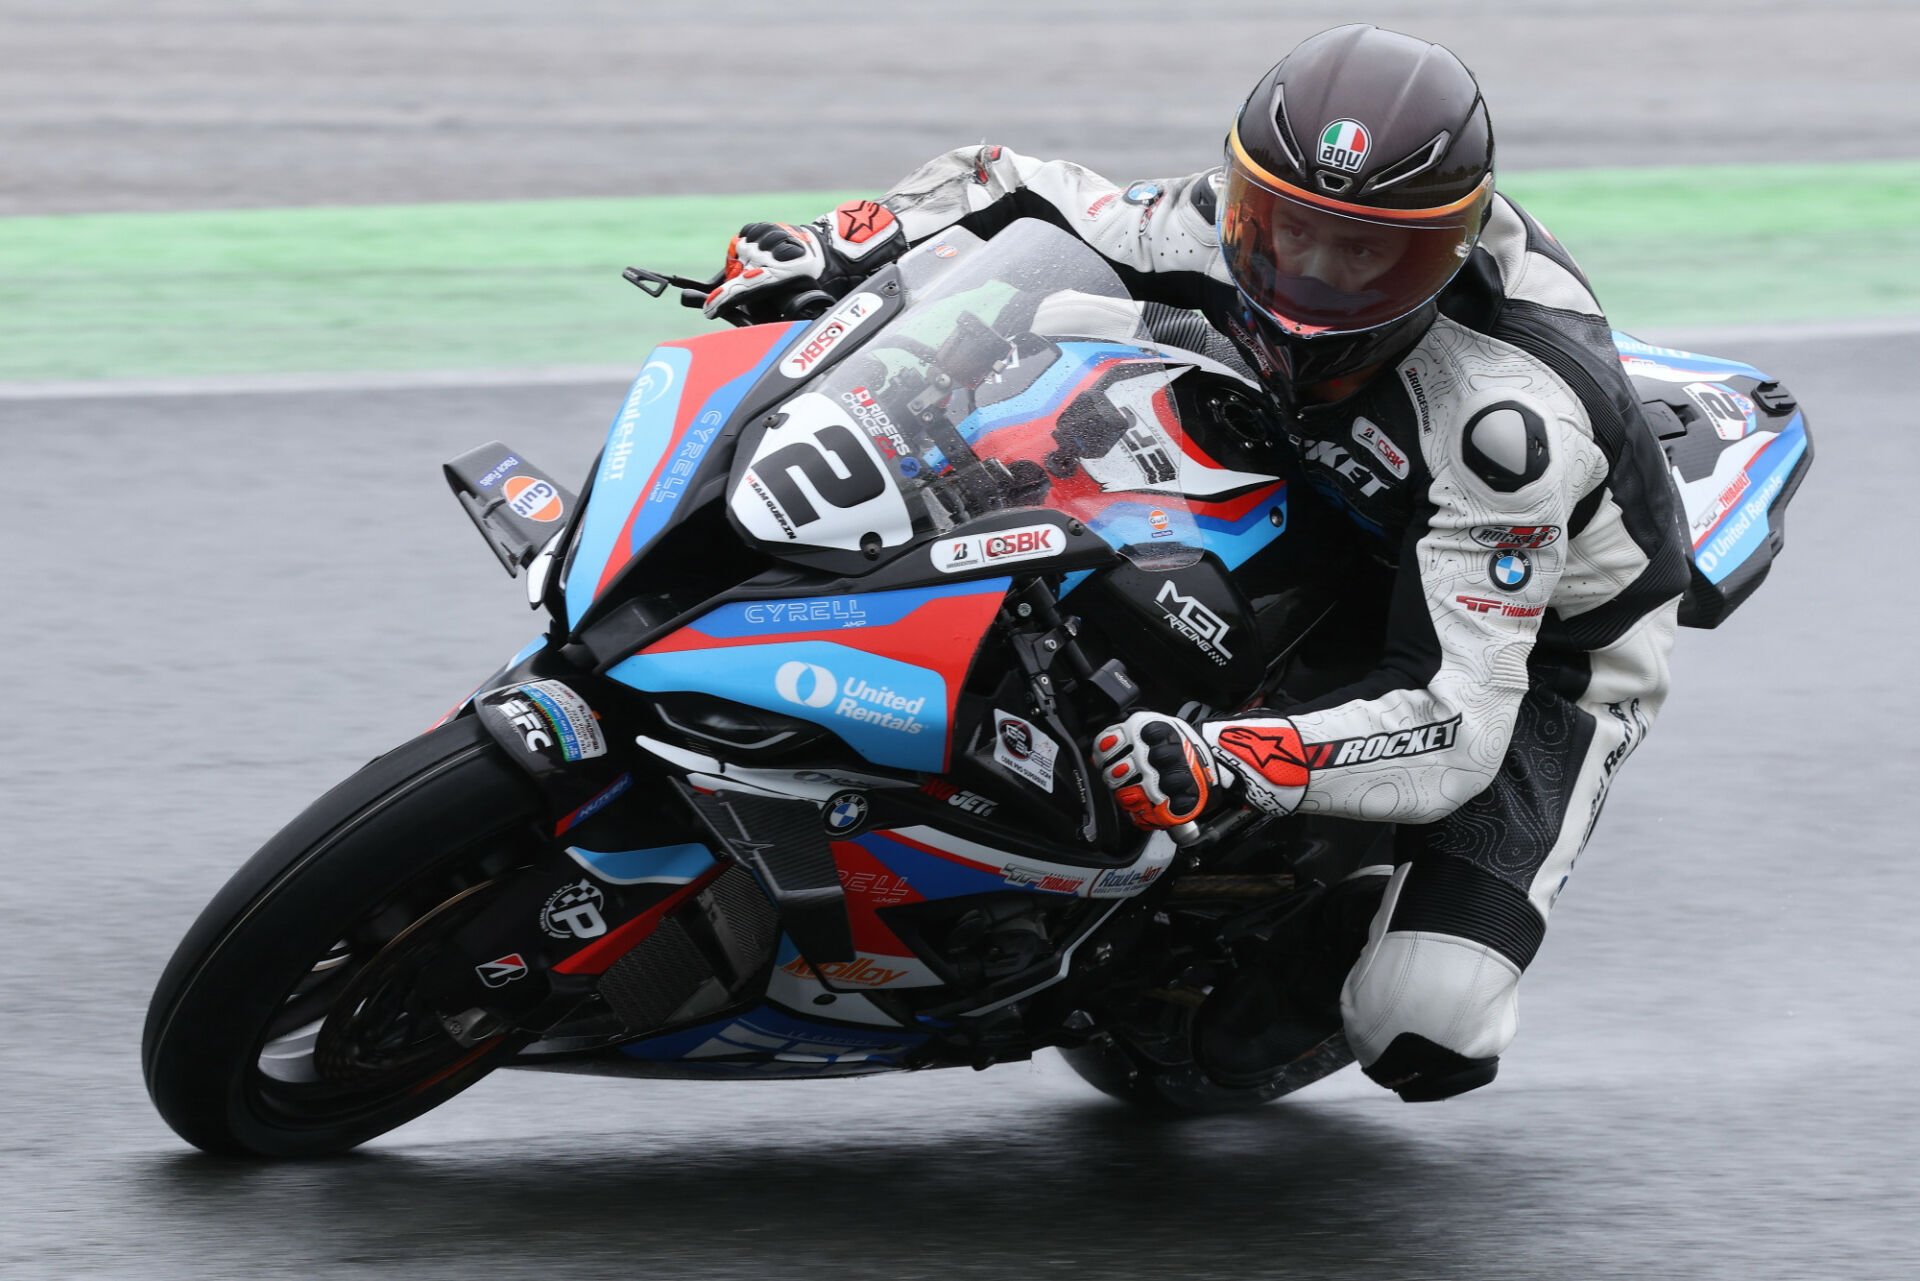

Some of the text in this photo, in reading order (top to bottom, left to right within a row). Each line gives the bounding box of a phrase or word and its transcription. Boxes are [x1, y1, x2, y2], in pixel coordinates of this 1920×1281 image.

[841, 392, 884, 436] CHOICE
[1698, 391, 1747, 421] 2
[868, 403, 911, 456] RIDERS
[655, 410, 722, 503] CYRELL
[1377, 439, 1405, 470] CSBK
[750, 425, 886, 528] 2
[751, 481, 769, 501] SAM
[513, 482, 553, 516] Gulf
[1712, 475, 1784, 557] United Rentals
[744, 599, 866, 624] CYRELL
[1163, 613, 1213, 652] RACING
[843, 677, 926, 715] United
[497, 699, 554, 753] EFC
[834, 697, 923, 735] Rentals
[1333, 718, 1461, 766] ROCKET
